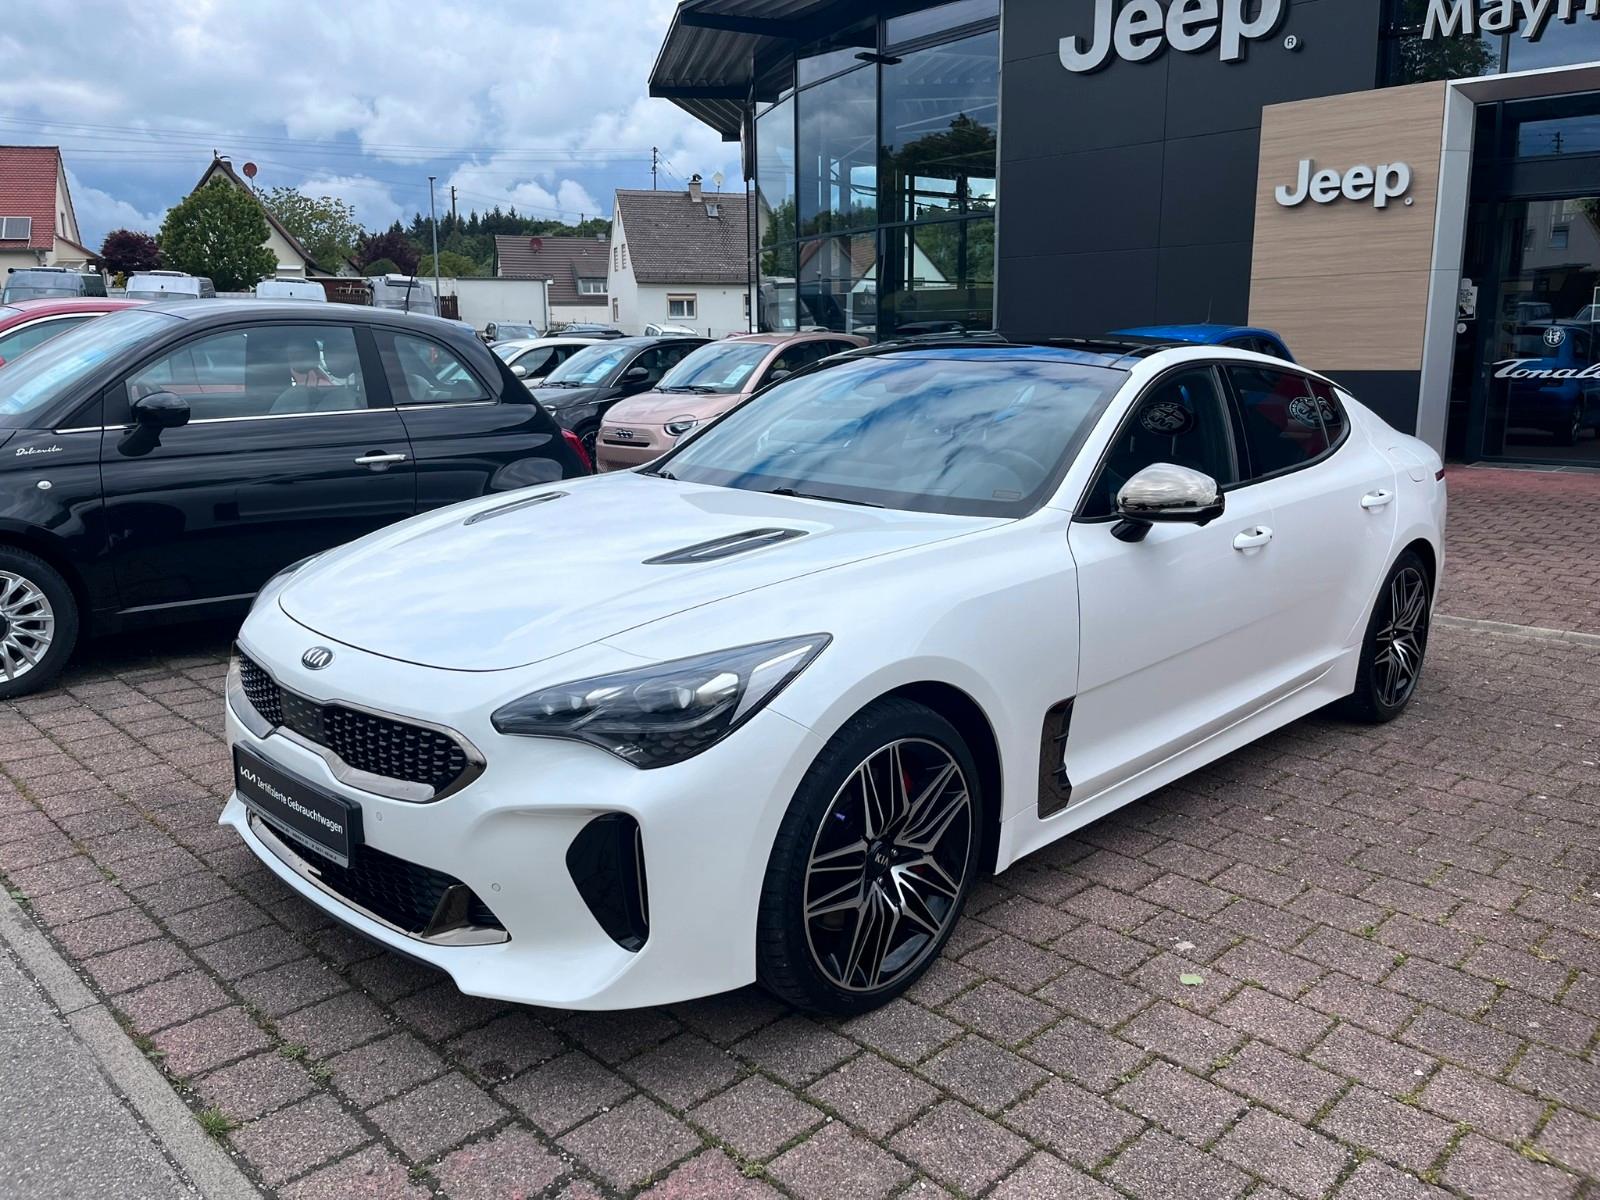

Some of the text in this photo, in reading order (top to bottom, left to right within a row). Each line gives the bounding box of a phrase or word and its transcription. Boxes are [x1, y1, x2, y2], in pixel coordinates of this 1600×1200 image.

[1058, 0, 1283, 73] Jeep
[1274, 159, 1412, 209] Jeep
[303, 647, 330, 667] KIA
[287, 796, 343, 835] Gebrauchtwagen
